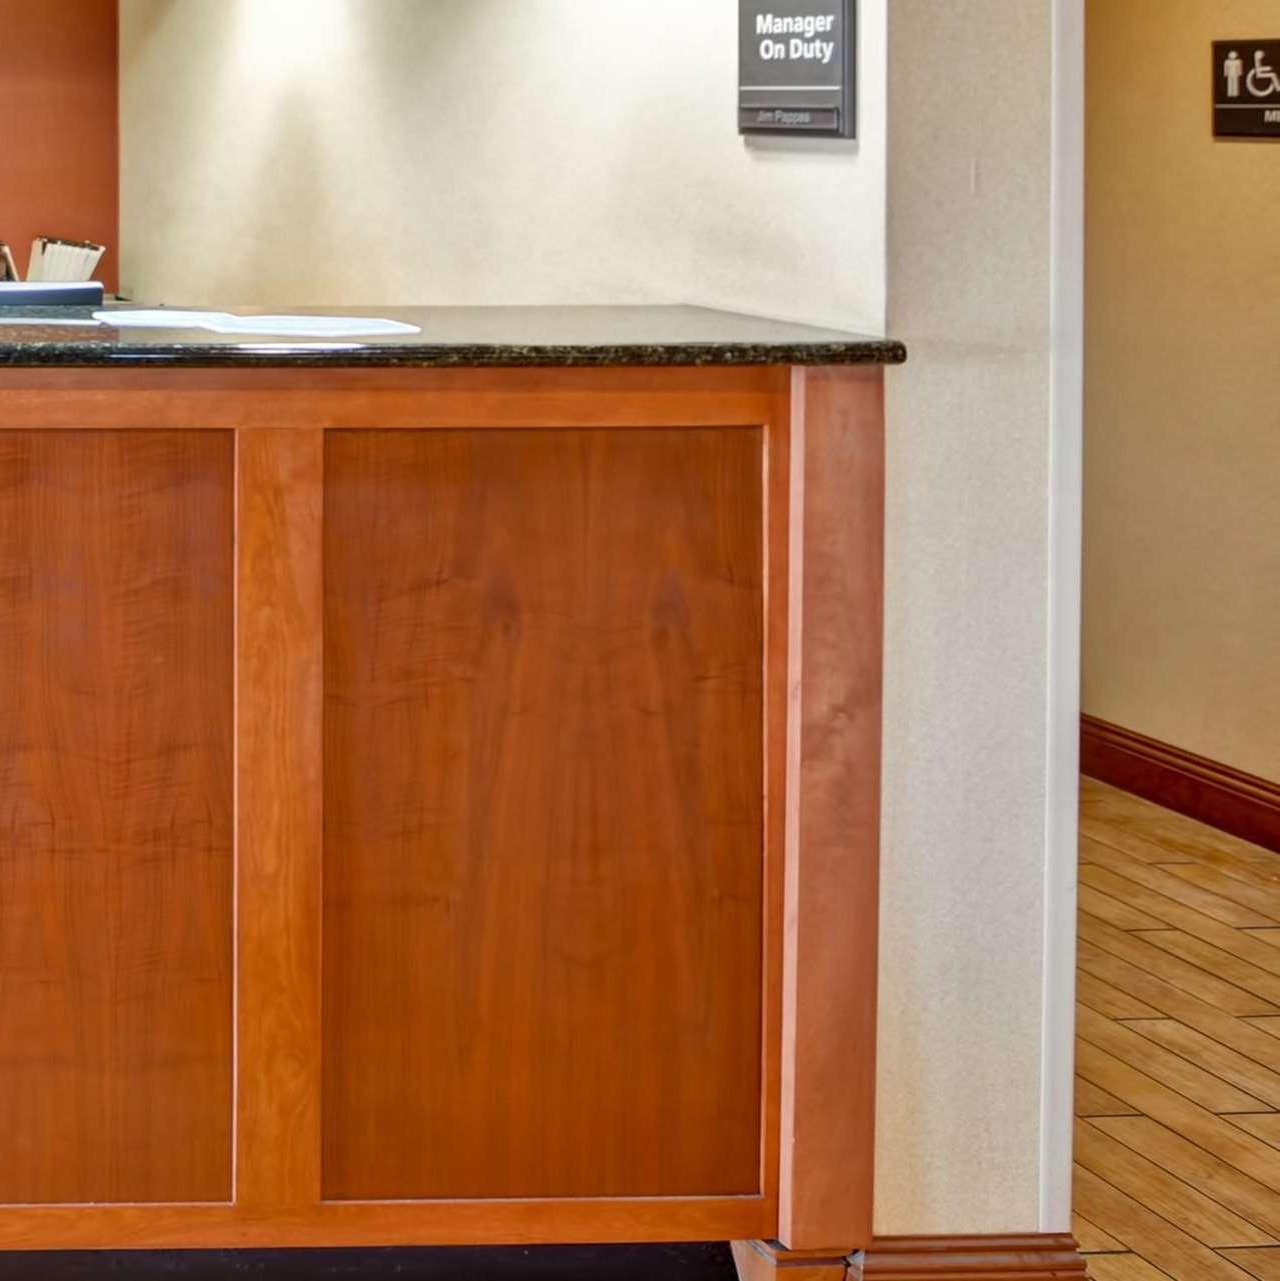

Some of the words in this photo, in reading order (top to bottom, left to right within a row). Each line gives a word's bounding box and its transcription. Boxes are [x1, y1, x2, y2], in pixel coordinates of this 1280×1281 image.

[756, 13, 834, 37] Manager
[760, 39, 785, 60] On
[789, 38, 834, 64] Duty
